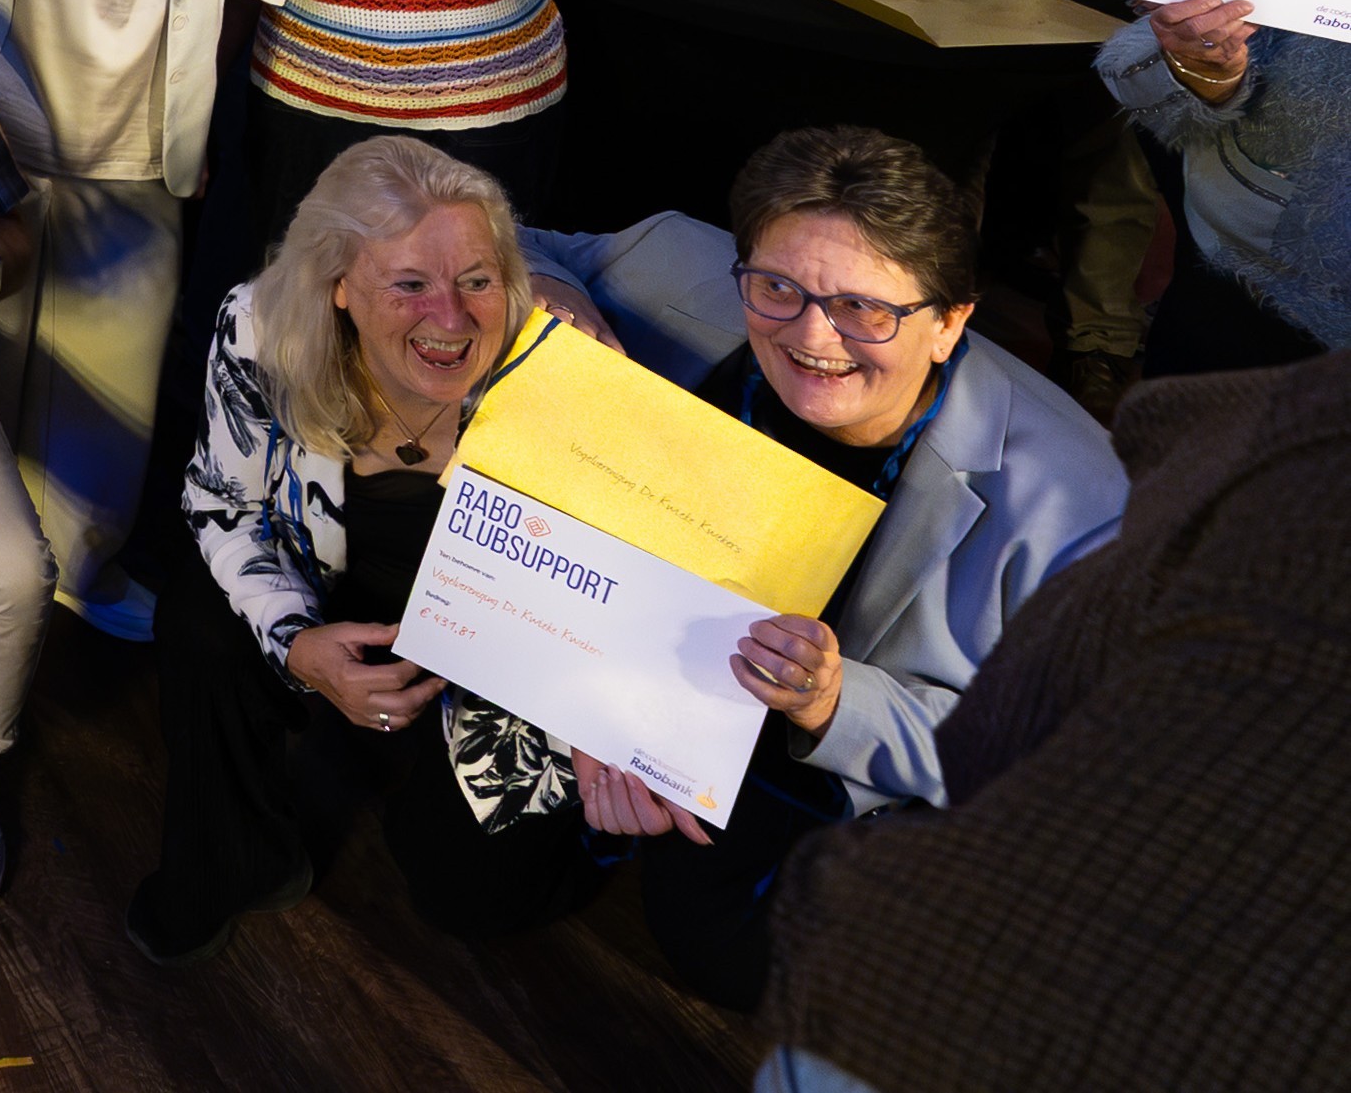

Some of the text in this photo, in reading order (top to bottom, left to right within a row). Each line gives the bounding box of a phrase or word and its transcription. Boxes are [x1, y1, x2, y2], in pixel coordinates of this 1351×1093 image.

[455, 481, 524, 530] RABO
[571, 443, 637, 493] Vogelvereniging
[639, 484, 657, 498] De
[698, 518, 742, 555] Kwekers
[447, 508, 618, 605] CLUBSUPPORT
[432, 566, 498, 610] Vogelvereniging
[502, 599, 519, 616] De
[629, 755, 695, 800] Rabobank
